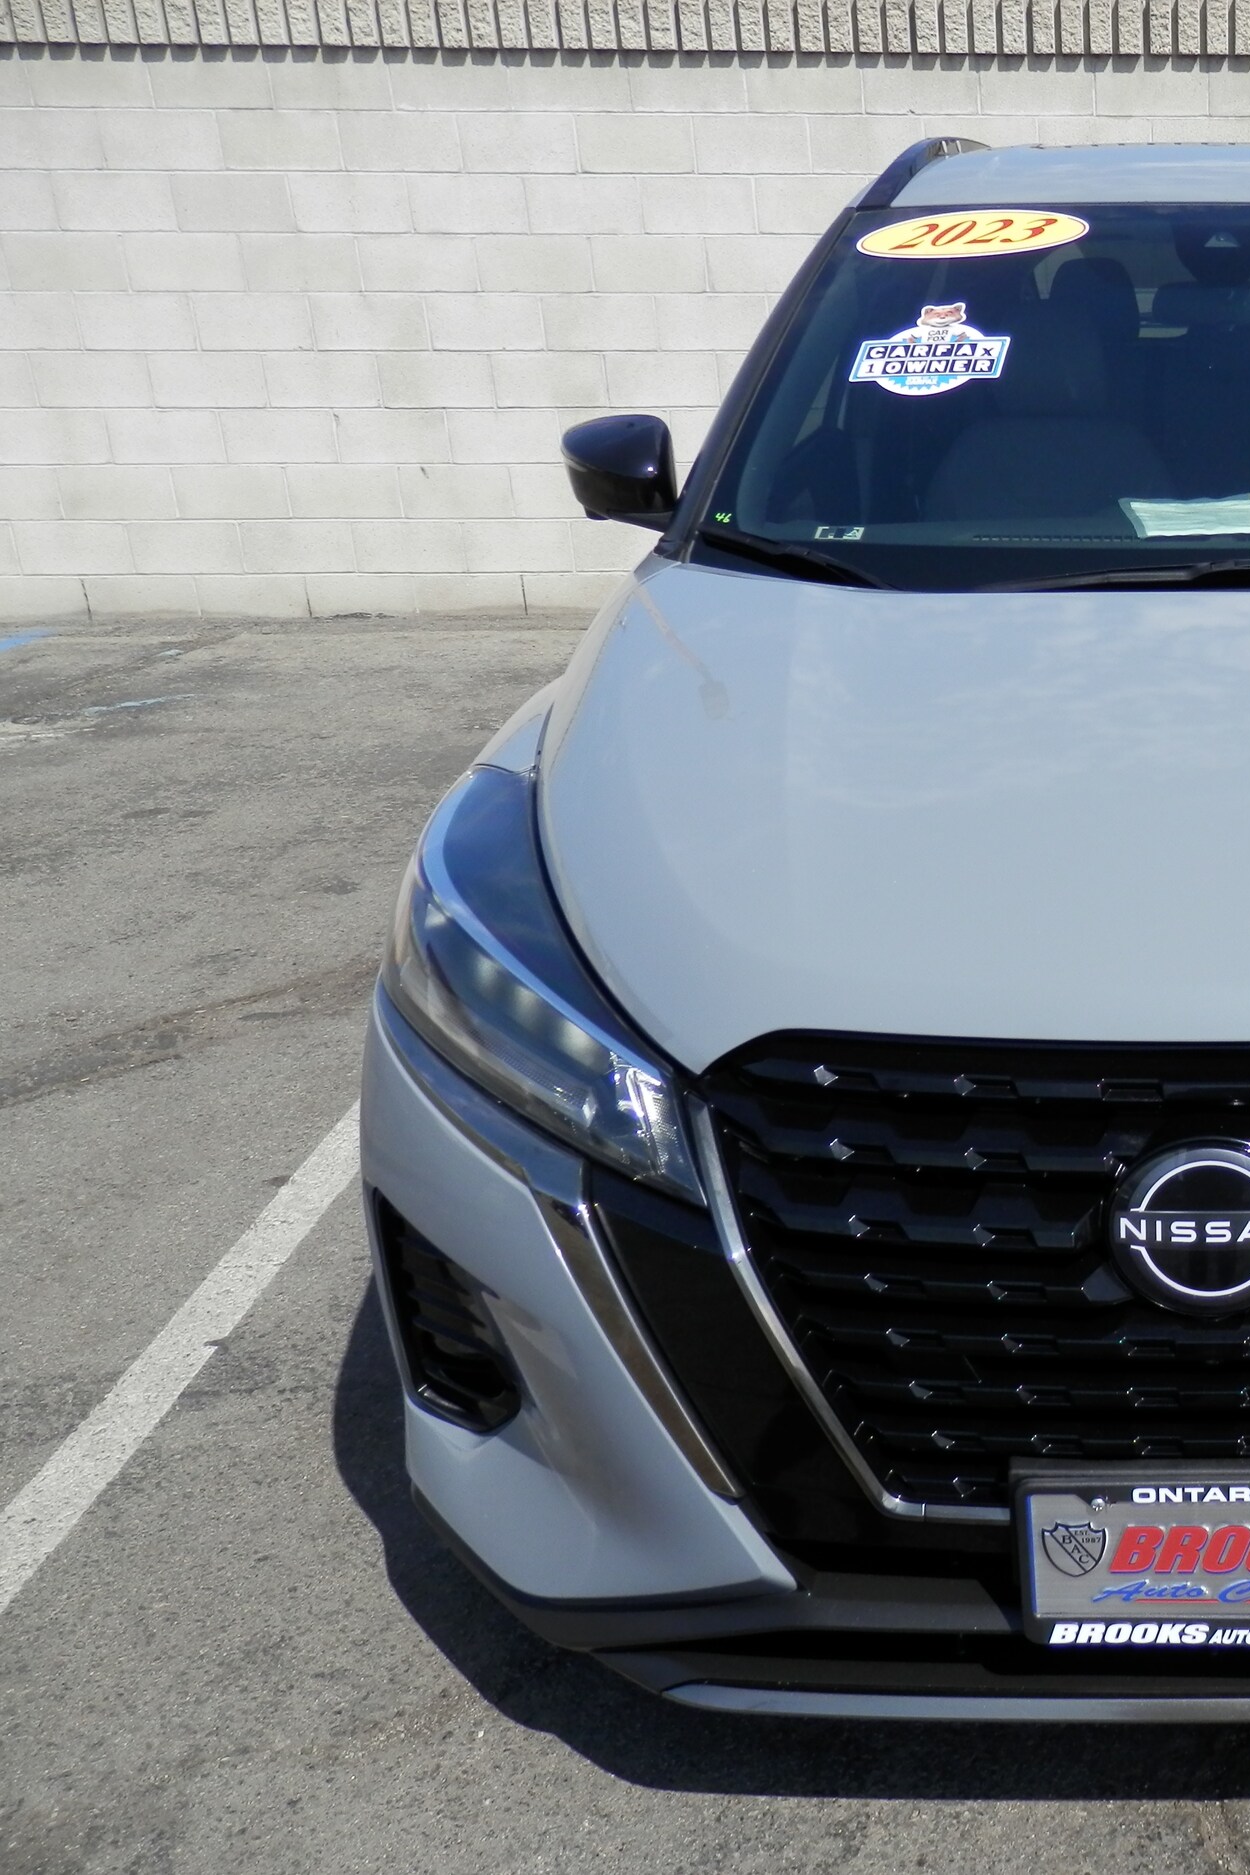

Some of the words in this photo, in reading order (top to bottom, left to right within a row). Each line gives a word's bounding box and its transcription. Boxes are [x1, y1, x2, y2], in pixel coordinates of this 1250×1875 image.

[888, 218, 1058, 250] 2023
[868, 344, 994, 359] CARFAX
[865, 363, 875, 374] 1
[885, 359, 991, 375] OWNER
[1093, 1579, 1209, 1603] Auto
